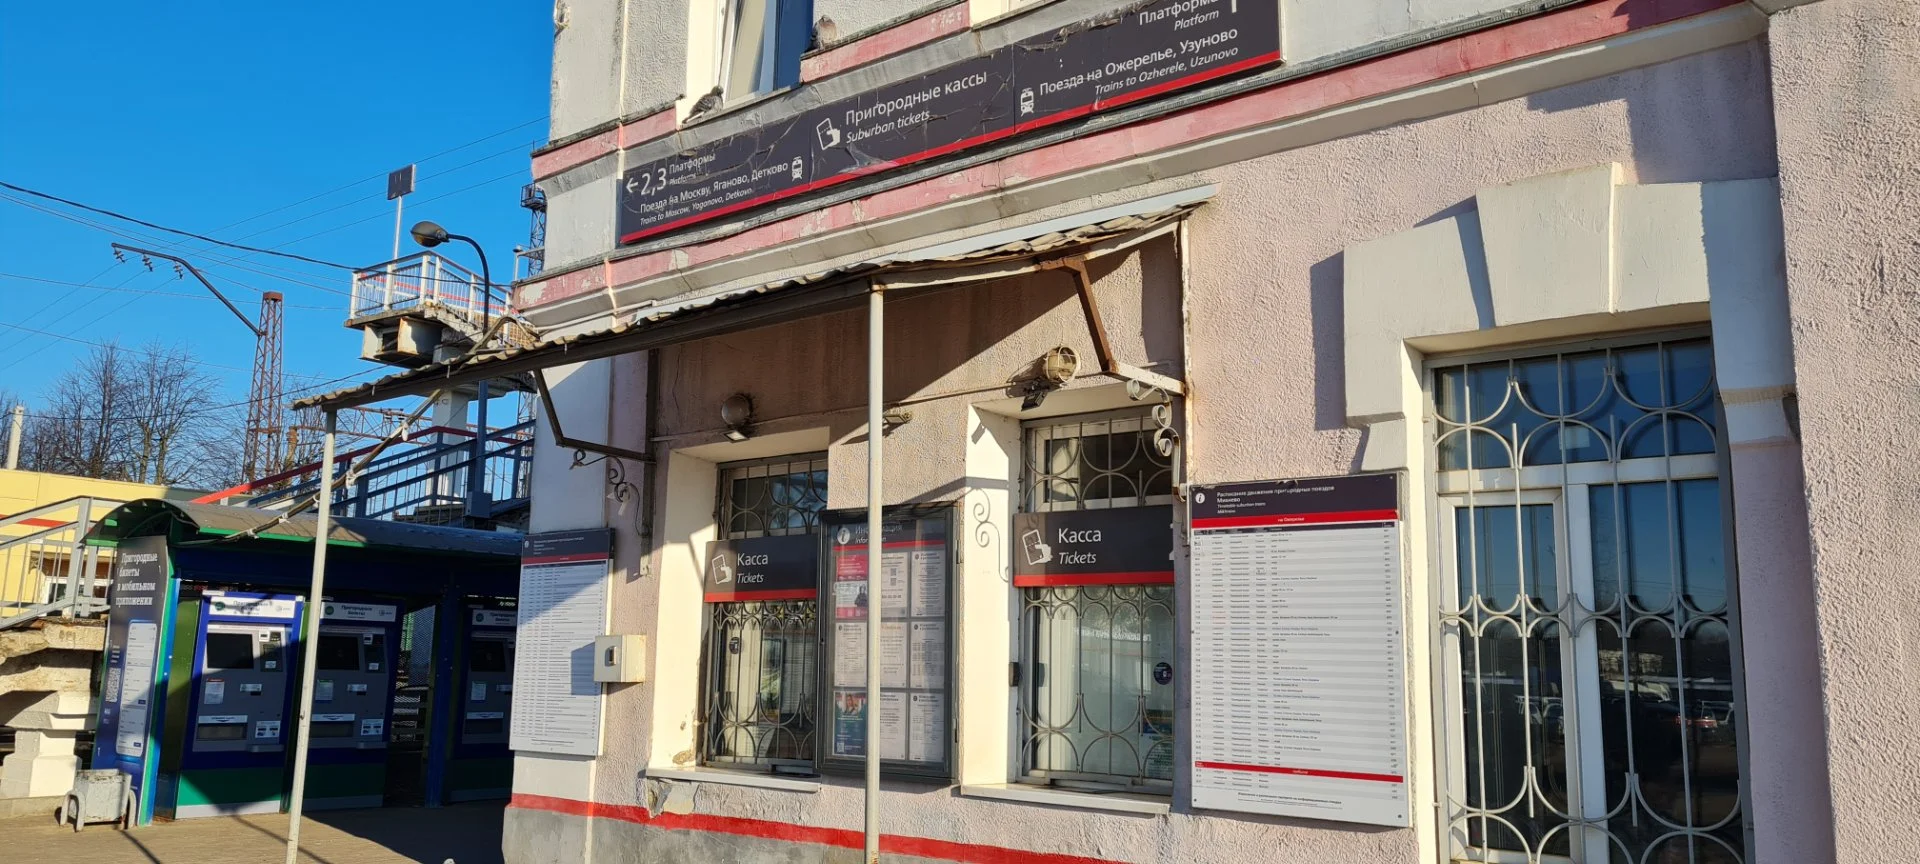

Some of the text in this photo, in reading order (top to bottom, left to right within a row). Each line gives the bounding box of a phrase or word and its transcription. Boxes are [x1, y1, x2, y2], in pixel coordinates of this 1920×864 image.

[1174, 10, 1219, 31] Platform
[1040, 28, 1238, 96] Поезда на Ожерелье, Узуново
[1095, 47, 1239, 96] Trains to Ozherele, Uzunovo
[846, 71, 987, 126] Пригородные кассы
[846, 110, 930, 144] Suburban tickets
[669, 153, 716, 174] Платформы
[640, 162, 789, 214] Поезда на Москву, Яганово, Детково
[641, 167, 666, 196] 2,3
[640, 214, 657, 225] Trains
[665, 206, 691, 218] Moscow,
[725, 187, 753, 201] Detkovo
[1058, 527, 1102, 544] Касса
[122, 552, 158, 566] Пригородные
[737, 552, 768, 566] Касса
[1058, 550, 1097, 565] Tickets
[119, 566, 140, 577] билеты
[737, 572, 764, 584] Tickets
